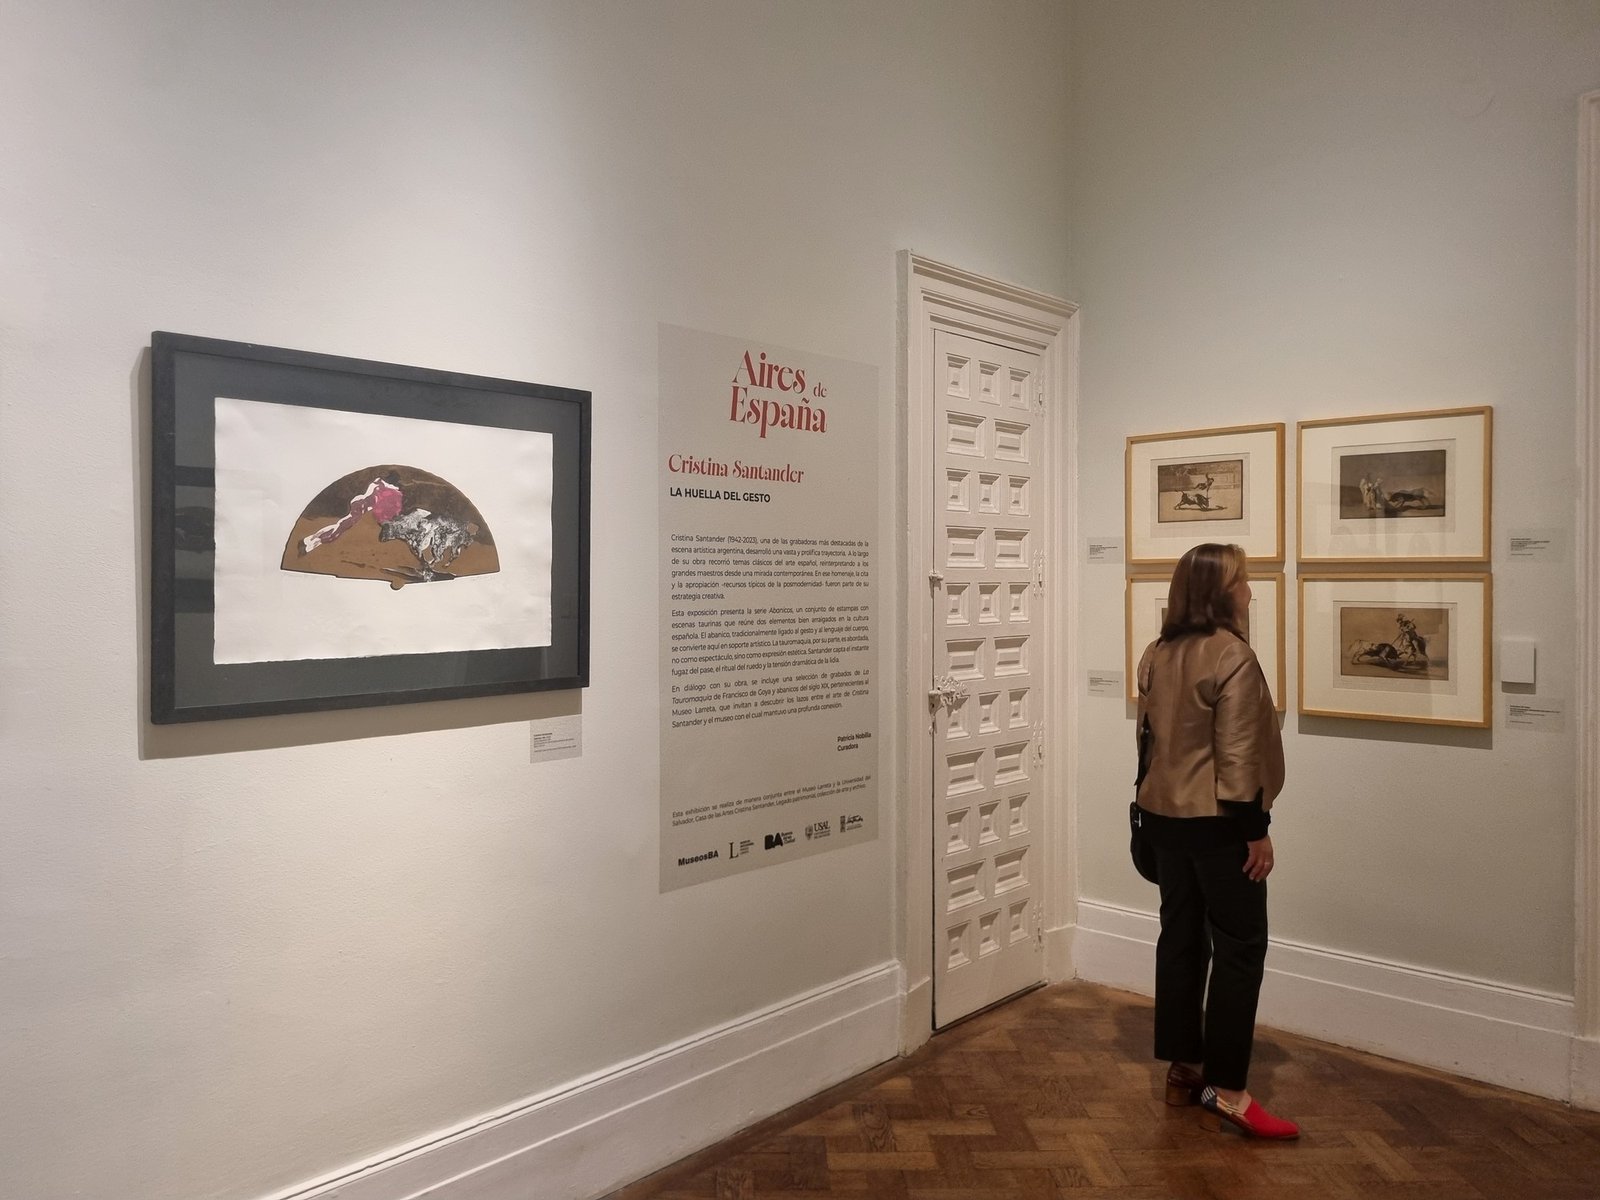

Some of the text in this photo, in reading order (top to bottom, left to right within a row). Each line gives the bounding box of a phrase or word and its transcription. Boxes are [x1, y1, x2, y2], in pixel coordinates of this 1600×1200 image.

[732, 350, 827, 398] Aires de
[729, 386, 827, 439] España
[668, 454, 805, 483] Cristina Santander
[670, 487, 771, 503] LA HUELLA DEL GESTO
[671, 534, 694, 542] Cristina
[695, 535, 726, 543] Santander
[671, 557, 680, 565] de
[671, 570, 696, 578] grandes
[677, 581, 683, 589] la
[671, 593, 701, 601] estrategia
[671, 609, 685, 617] Esta
[700, 631, 707, 639] El
[679, 644, 707, 652] convierte
[680, 656, 698, 664] como
[734, 652, 746, 660] sino
[671, 668, 689, 677] fugaz
[689, 667, 699, 675] del
[715, 665, 721, 673] el
[721, 664, 737, 672] ritual
[736, 663, 746, 671] del
[671, 685, 681, 693] En
[683, 684, 707, 692] diálogo
[671, 695, 713, 704] Tauromaquia
[713, 693, 722, 701] de
[722, 691, 749, 699] Francisco
[719, 704, 731, 712] que
[672, 719, 703, 728] Santander
[708, 716, 714, 724] el
[714, 715, 734, 723] museo
[745, 712, 751, 720] el
[751, 710, 763, 719] cual
[814, 820, 831, 831] USAL
[764, 832, 783, 850] BA
[678, 850, 719, 866] MuseosBA
